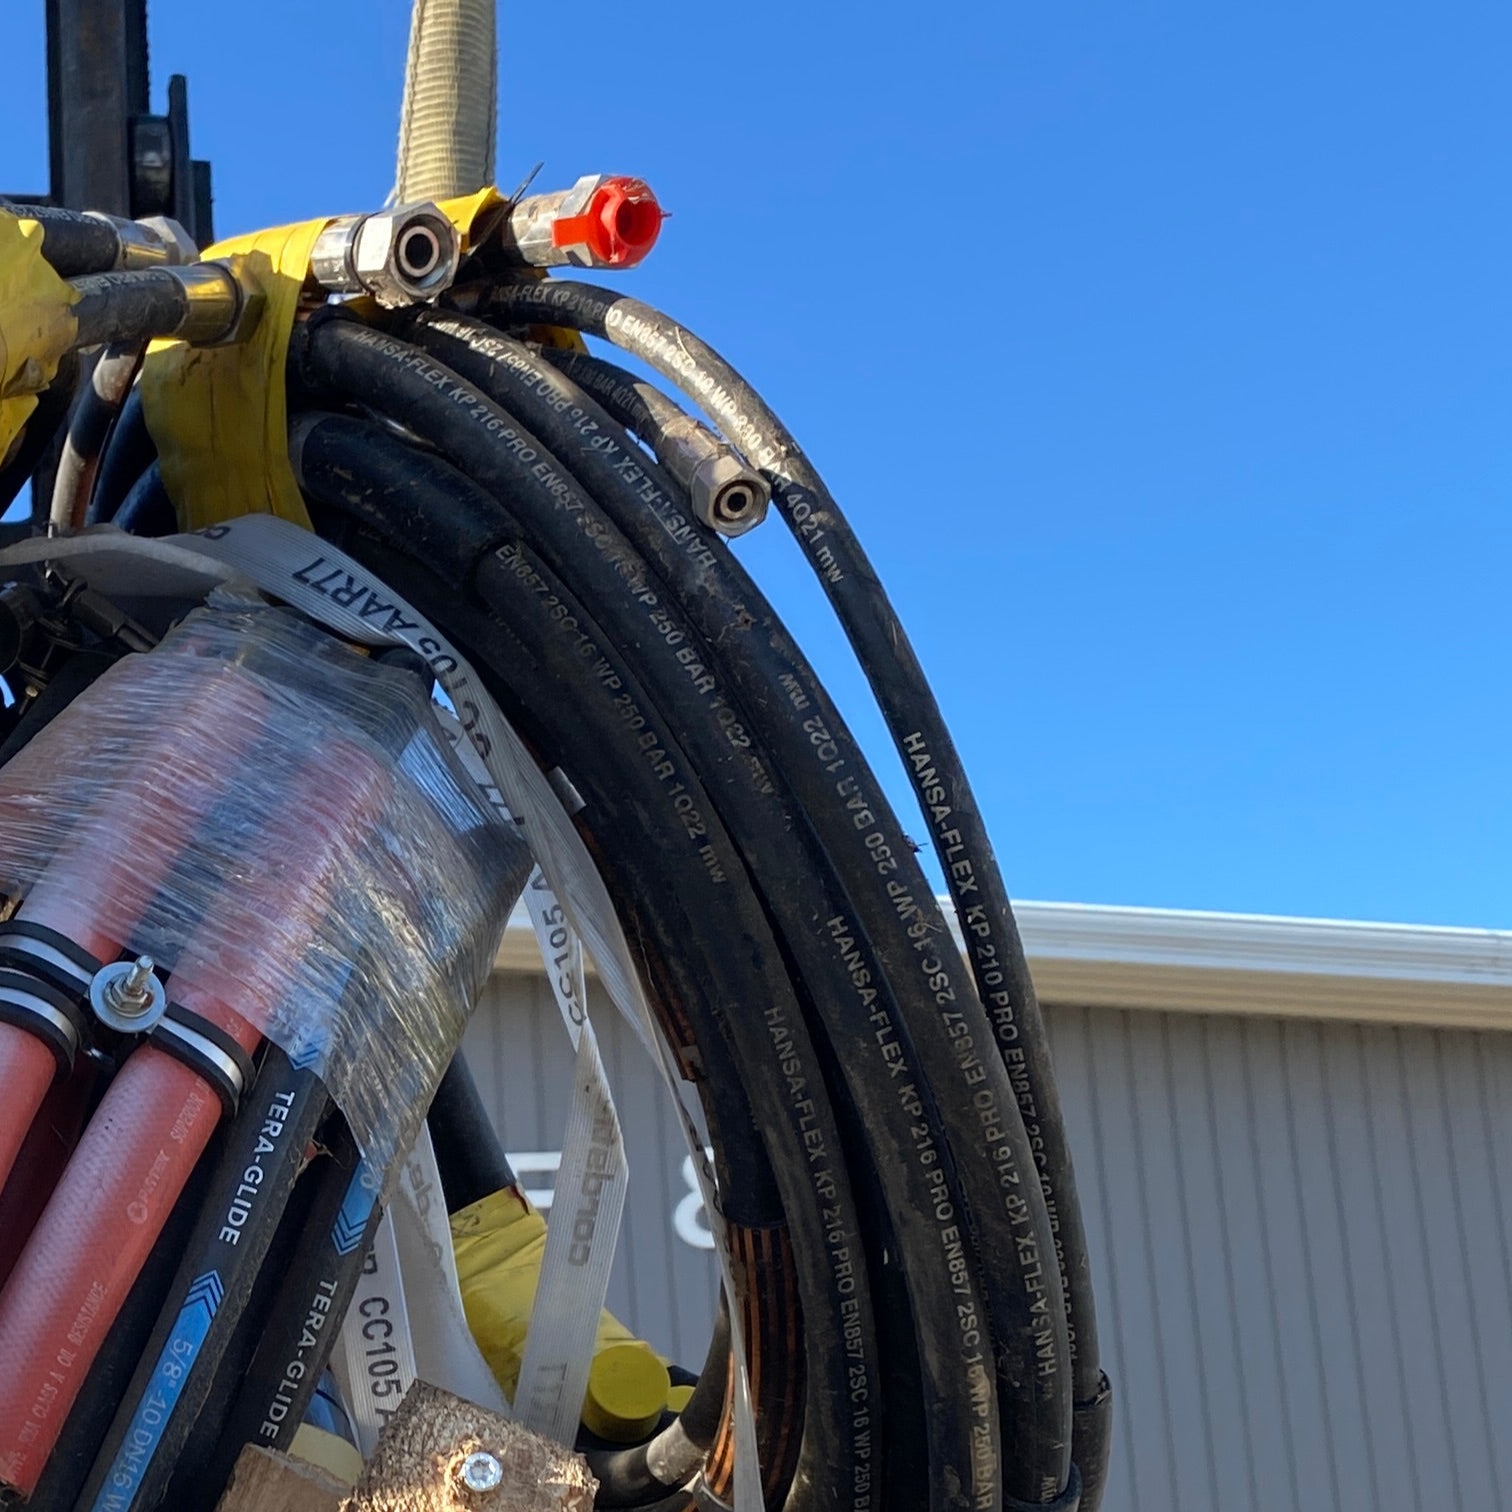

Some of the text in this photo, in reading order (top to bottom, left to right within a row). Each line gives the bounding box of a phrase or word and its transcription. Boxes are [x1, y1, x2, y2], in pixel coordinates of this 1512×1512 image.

[536, 379, 719, 570] HANSA-FLEX KP PRO
[710, 385, 741, 421] WP
[786, 490, 826, 546] 4Q21
[815, 545, 846, 587] mw
[354, 329, 453, 392] HANSA-FLEX
[449, 386, 477, 411] KP
[469, 402, 501, 431] 216
[496, 426, 538, 464] PRO
[649, 607, 686, 648] 250
[675, 647, 716, 696] BAR
[291, 555, 422, 634] AAR77
[778, 671, 811, 713] mw
[592, 655, 623, 692] WP
[638, 729, 676, 782] BAR
[672, 780, 708, 841] 1Q22
[699, 842, 728, 885] mw
[902, 731, 979, 897] HANSA-FLEX
[863, 831, 898, 876] 250
[886, 879, 920, 922] WP
[965, 904, 992, 939] KP
[921, 955, 956, 1006] 2SC
[975, 943, 1005, 986] 210
[826, 914, 909, 1079] HANSA-FLEX
[988, 989, 1019, 1043] PRO
[942, 1009, 986, 1086] EN857
[763, 1005, 827, 1163] HANSA-FLEX
[897, 1083, 923, 1119] KP
[972, 1089, 1008, 1142] PRO
[218, 1090, 296, 1246] TERA-GLIDE
[909, 1122, 938, 1165] 216
[991, 1145, 1021, 1190] 216
[813, 1169, 838, 1200] KP
[924, 1167, 954, 1221] PRO
[1004, 1195, 1031, 1226] KP
[831, 1246, 855, 1294] PRO
[940, 1226, 971, 1296] EN857
[53, 1371, 66, 1387] A
[66, 1279, 109, 1348] RESISTANCE
[359, 1295, 405, 1399] CC105
[840, 1299, 865, 1361] EN857
[957, 1301, 981, 1349] 2SC
[258, 1280, 338, 1440] TERA-GLIDE
[847, 1365, 869, 1404] 2SC
[852, 1406, 870, 1427] 16
[967, 1377, 988, 1419] WP
[853, 1430, 873, 1464] WP
[853, 1465, 871, 1495] 250
